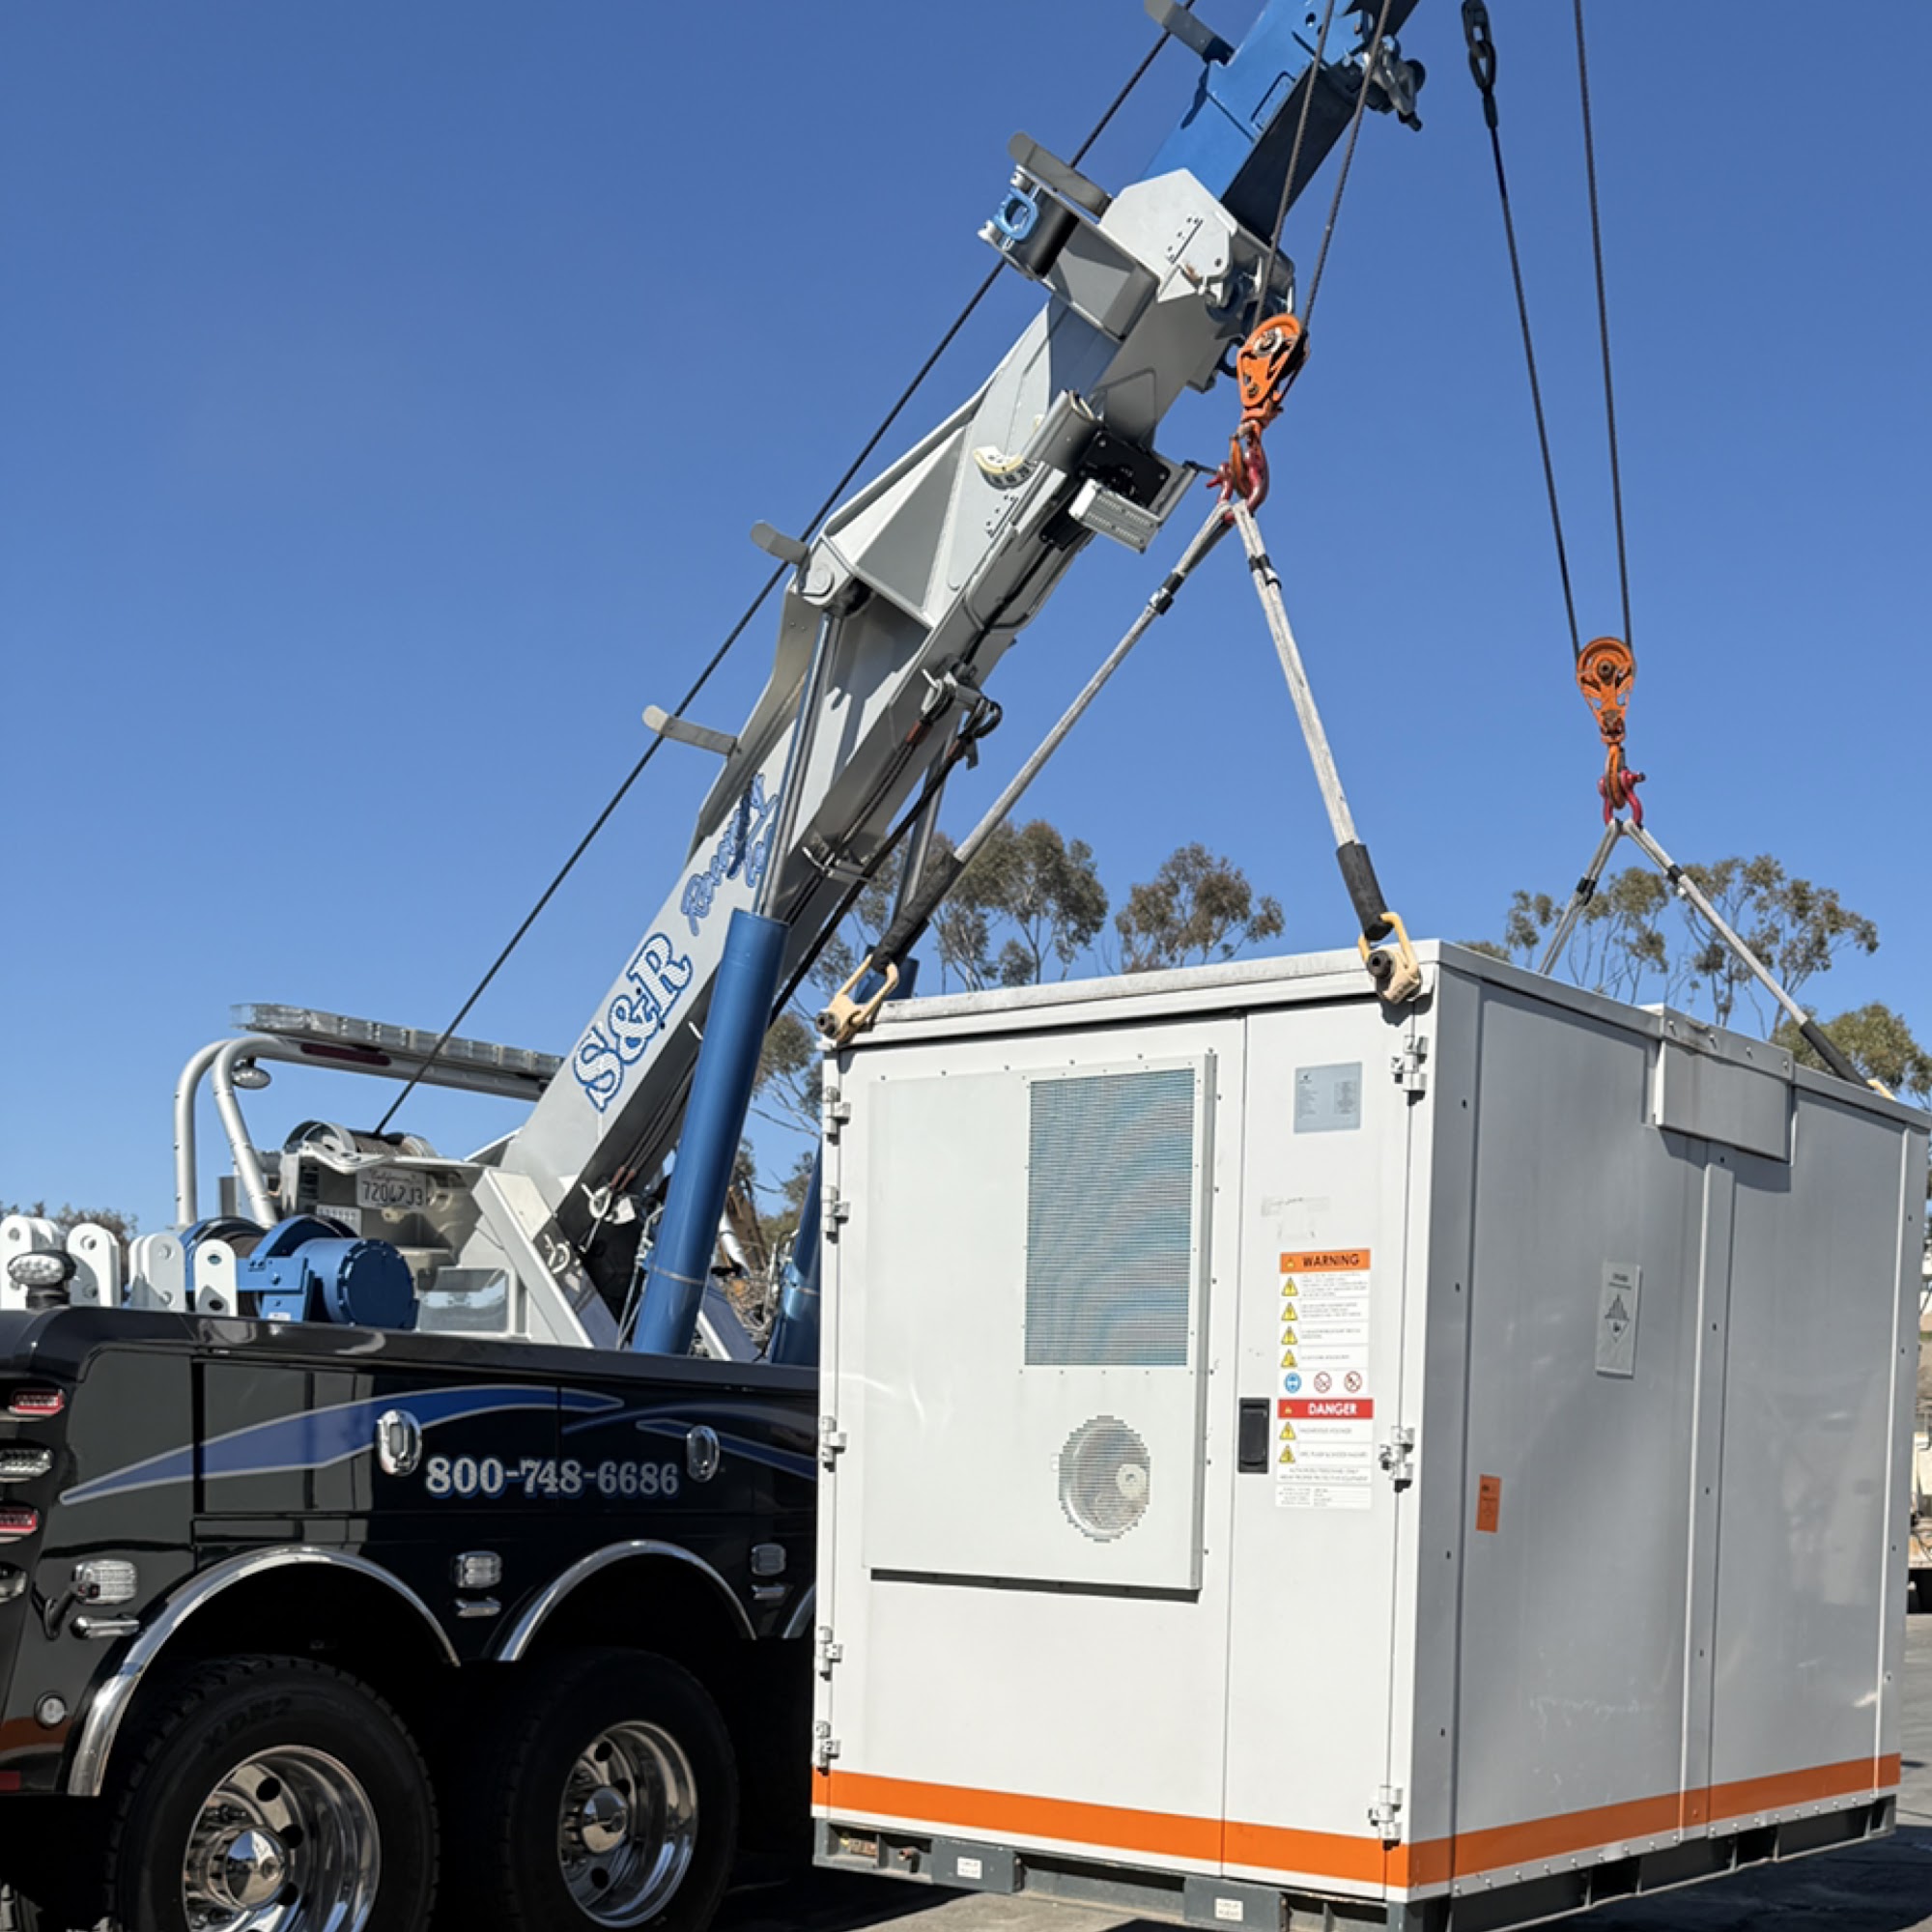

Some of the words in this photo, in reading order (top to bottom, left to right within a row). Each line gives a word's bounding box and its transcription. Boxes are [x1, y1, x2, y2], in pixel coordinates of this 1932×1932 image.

[573, 932, 693, 1113] S&R
[1302, 1253, 1360, 1267] WARNING
[1307, 1403, 1357, 1415] DANGER
[425, 1457, 679, 1497] 800-748-6686
